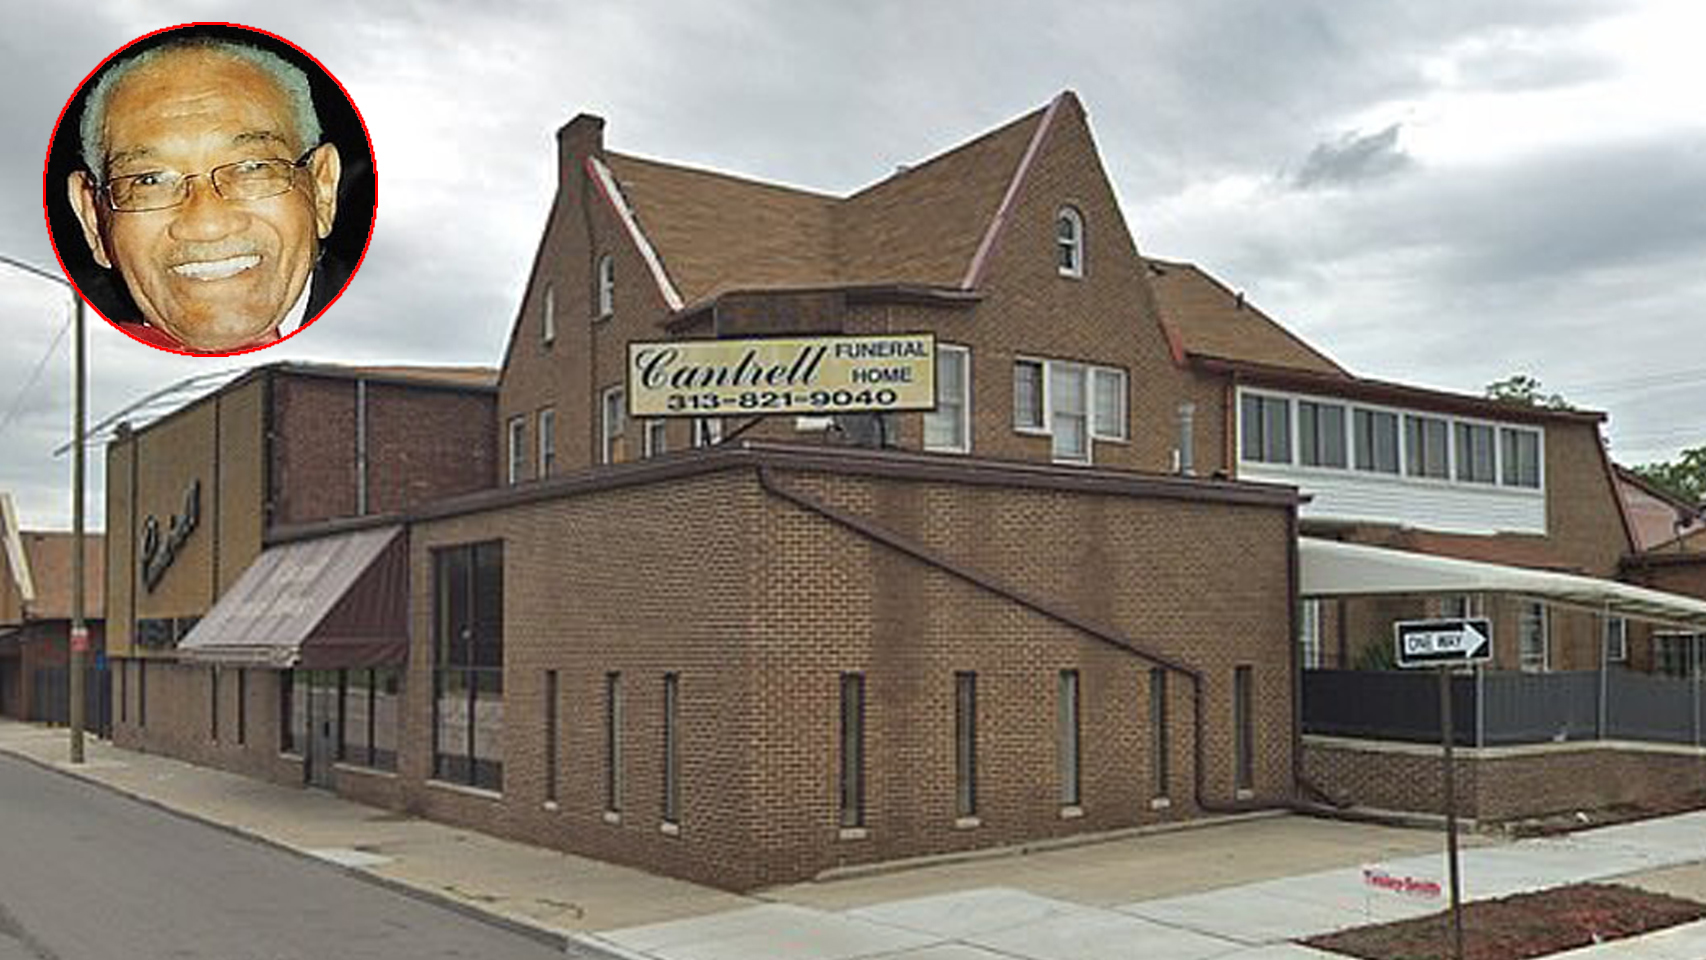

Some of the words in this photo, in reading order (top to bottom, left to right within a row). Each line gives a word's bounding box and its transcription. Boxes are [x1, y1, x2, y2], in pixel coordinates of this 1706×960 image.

[834, 342, 929, 358] FUNERAL
[634, 345, 828, 390] Cantrell
[851, 366, 912, 383] HOME
[666, 388, 898, 410] 313-821-9040
[1408, 636, 1433, 651] ONE
[1437, 634, 1463, 648] WAY
